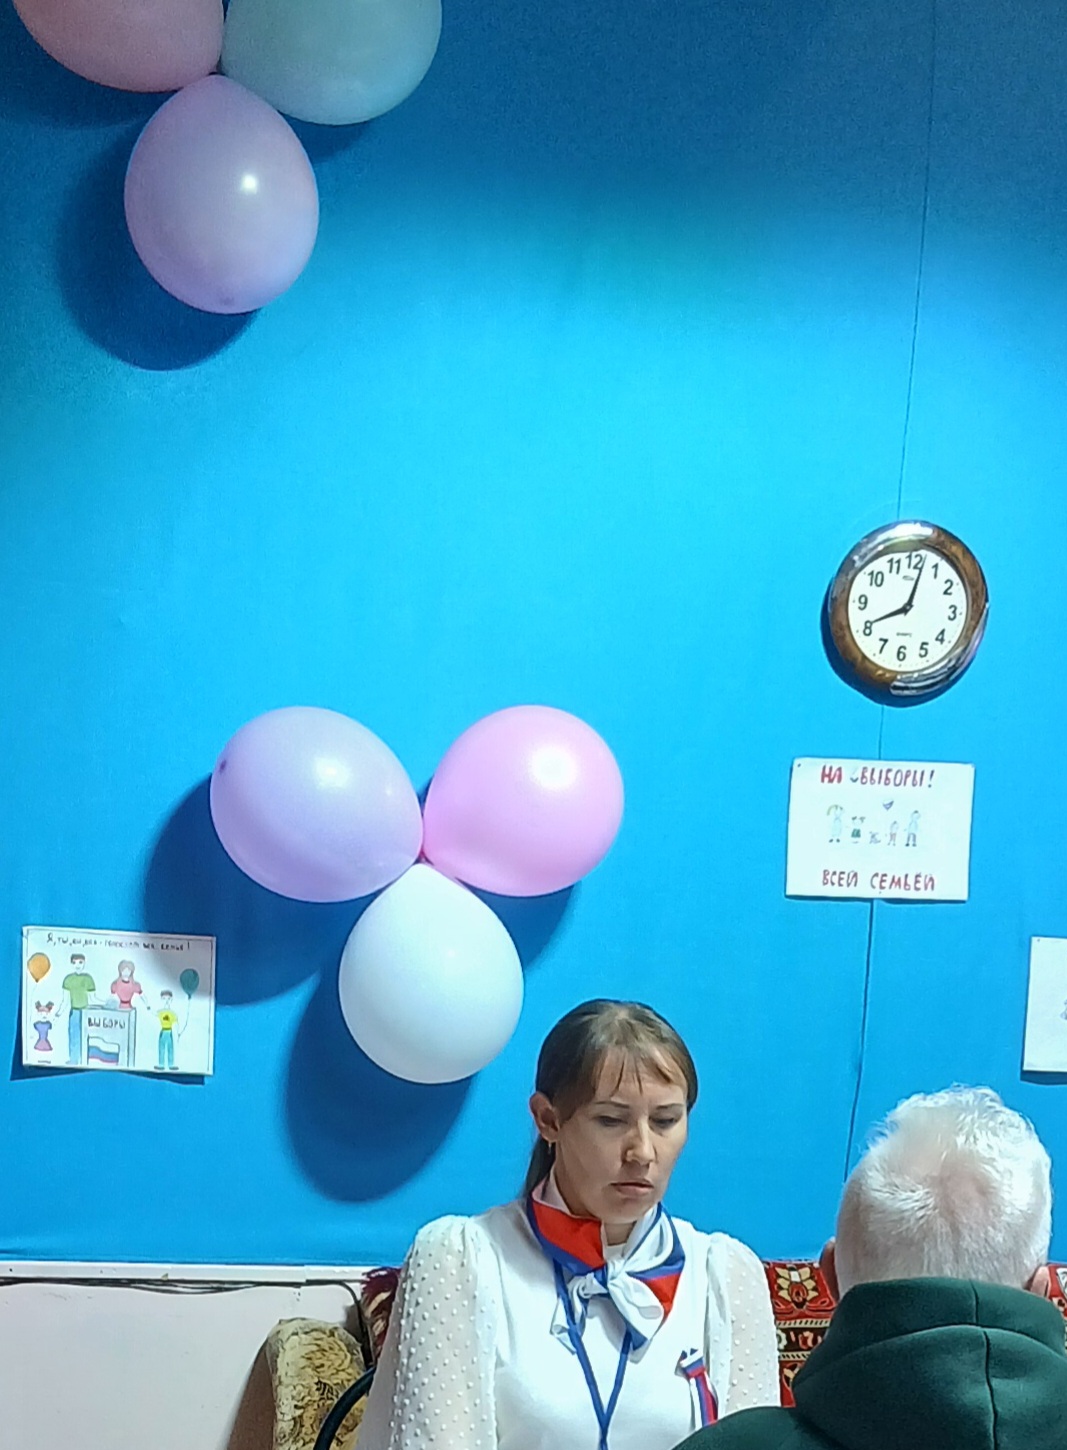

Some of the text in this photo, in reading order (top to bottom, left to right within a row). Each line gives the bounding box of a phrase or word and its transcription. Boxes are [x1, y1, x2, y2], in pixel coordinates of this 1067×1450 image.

[887, 557, 901, 575] 11
[905, 553, 923, 571] 12
[931, 562, 939, 579] 1
[868, 570, 885, 587] 10
[943, 580, 954, 596] 2
[858, 594, 868, 611] 9
[948, 604, 957, 621] 3
[863, 620, 872, 637] 8
[935, 629, 946, 645] 4
[878, 638, 888, 655] 7
[896, 645, 907, 662] 6
[919, 642, 929, 658] 5
[820, 764, 843, 784] НА
[822, 869, 858, 888] ВСЕЙ
[87, 1016, 126, 1029] ВЫБОРЫ
